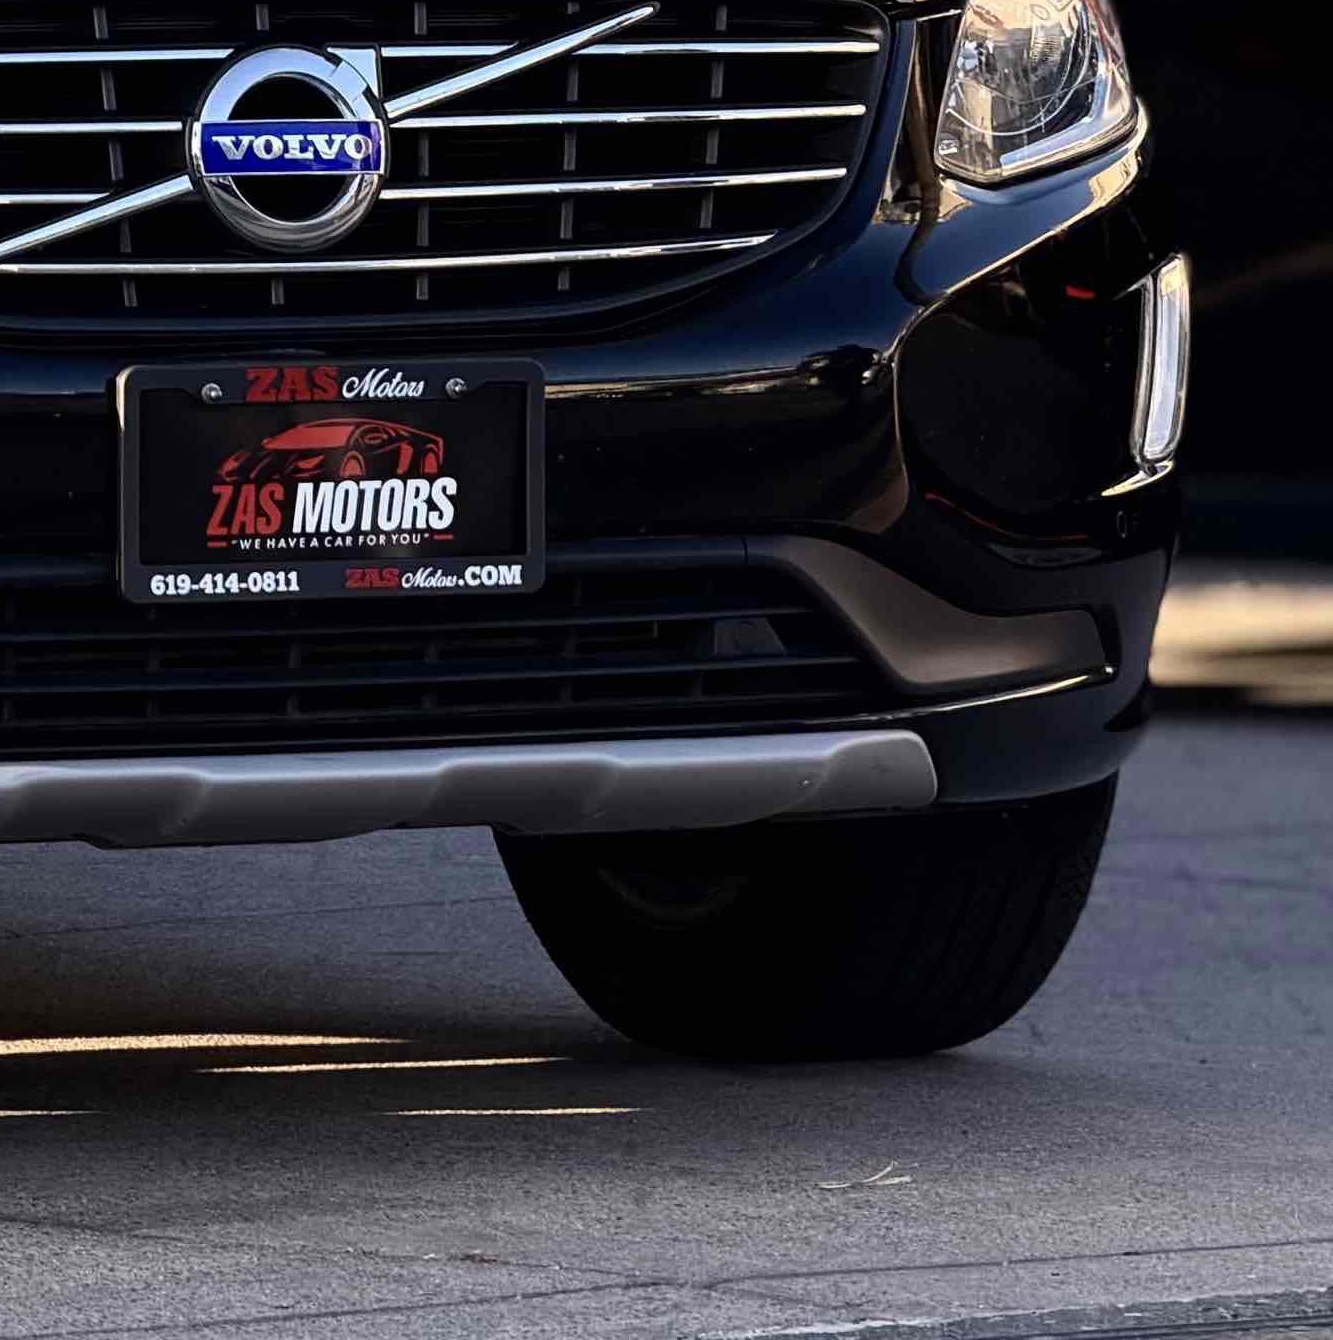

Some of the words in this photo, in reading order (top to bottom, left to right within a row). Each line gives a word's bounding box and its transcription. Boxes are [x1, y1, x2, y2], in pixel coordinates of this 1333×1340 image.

[212, 133, 373, 160] VOLVO
[244, 365, 340, 403] ZAS
[342, 367, 425, 399] Motors
[206, 483, 285, 536] ZAS
[292, 477, 458, 534] MOTORS
[266, 536, 306, 549] HAVE
[309, 536, 320, 548] A
[324, 535, 353, 548] CAR
[358, 534, 386, 547] FOR
[150, 571, 301, 596] 619-414-0811
